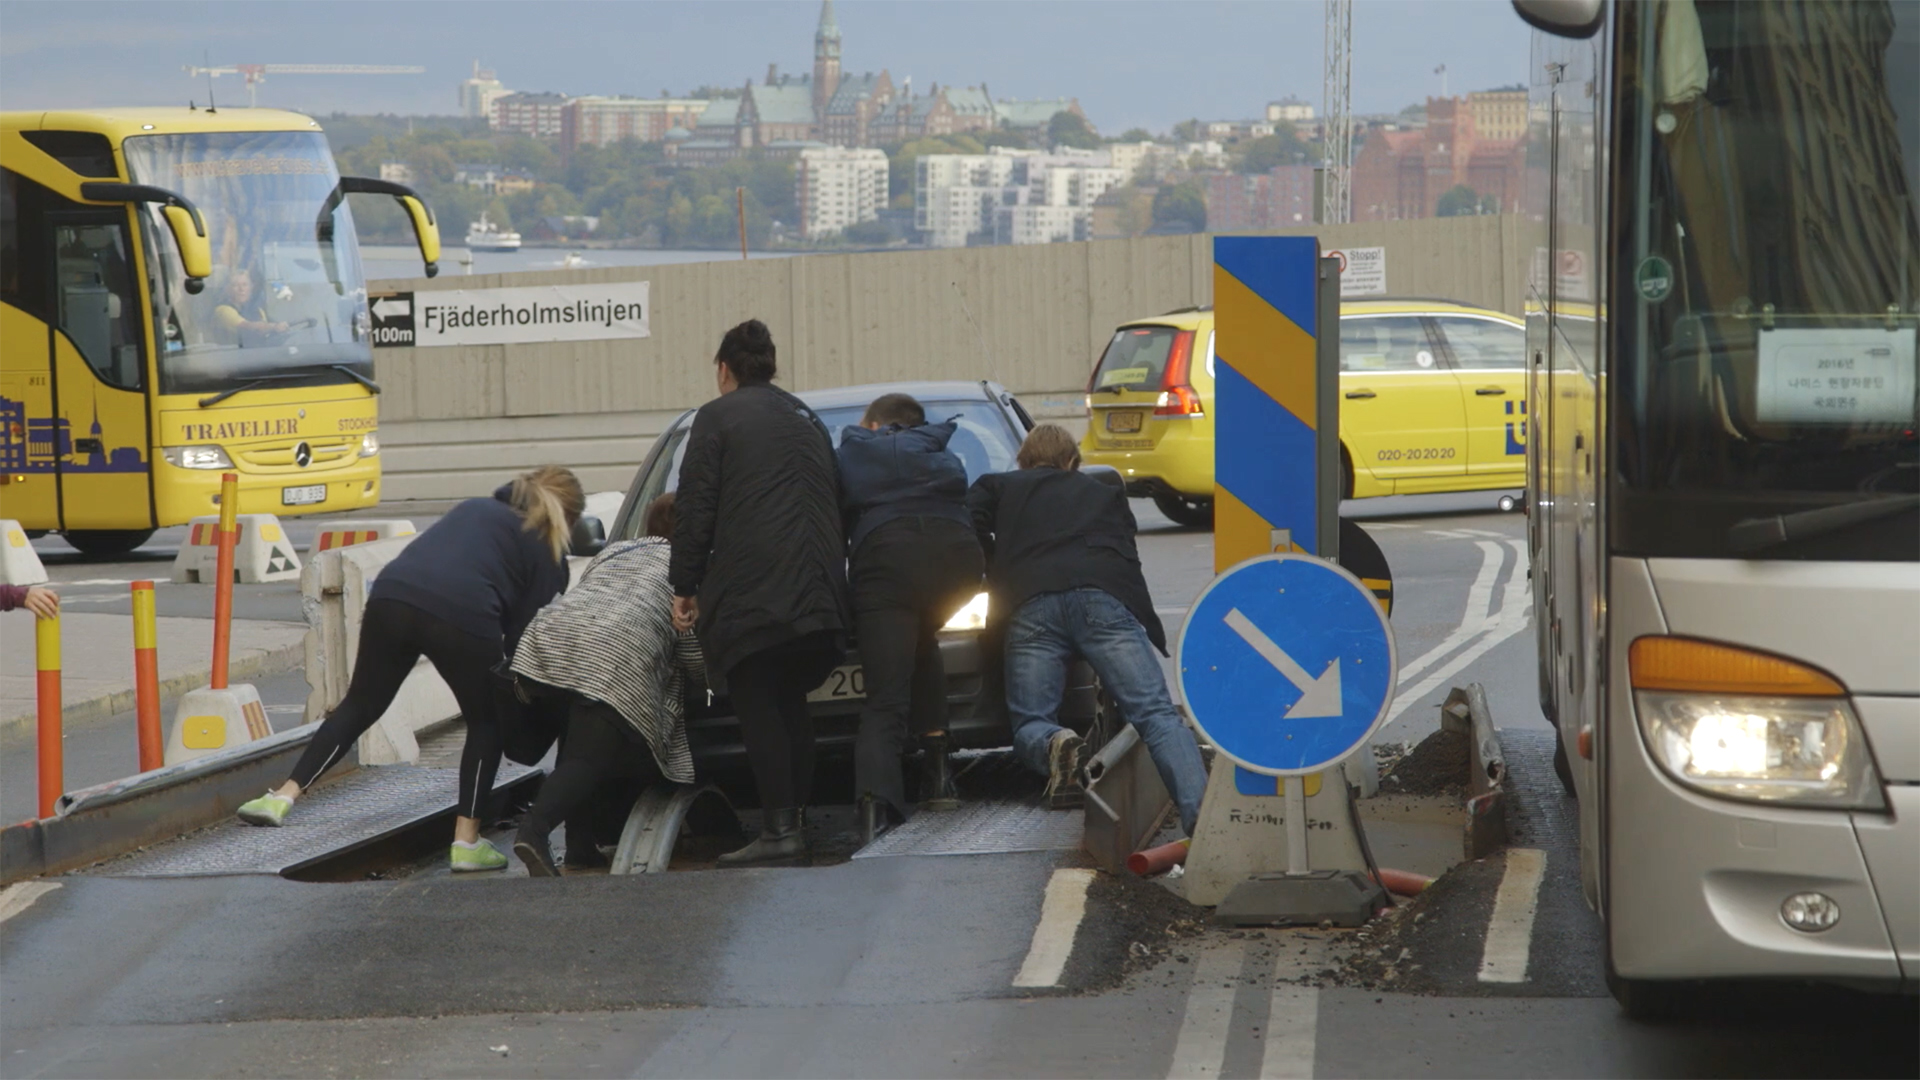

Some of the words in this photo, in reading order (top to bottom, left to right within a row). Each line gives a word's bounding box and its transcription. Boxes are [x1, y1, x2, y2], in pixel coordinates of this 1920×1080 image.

[1350, 249, 1381, 260] Stopp!
[425, 299, 642, 334] Fjäderholmslinjen
[373, 327, 413, 342] 100m
[182, 418, 299, 441] TRAVELLER
[831, 668, 867, 697] 20
